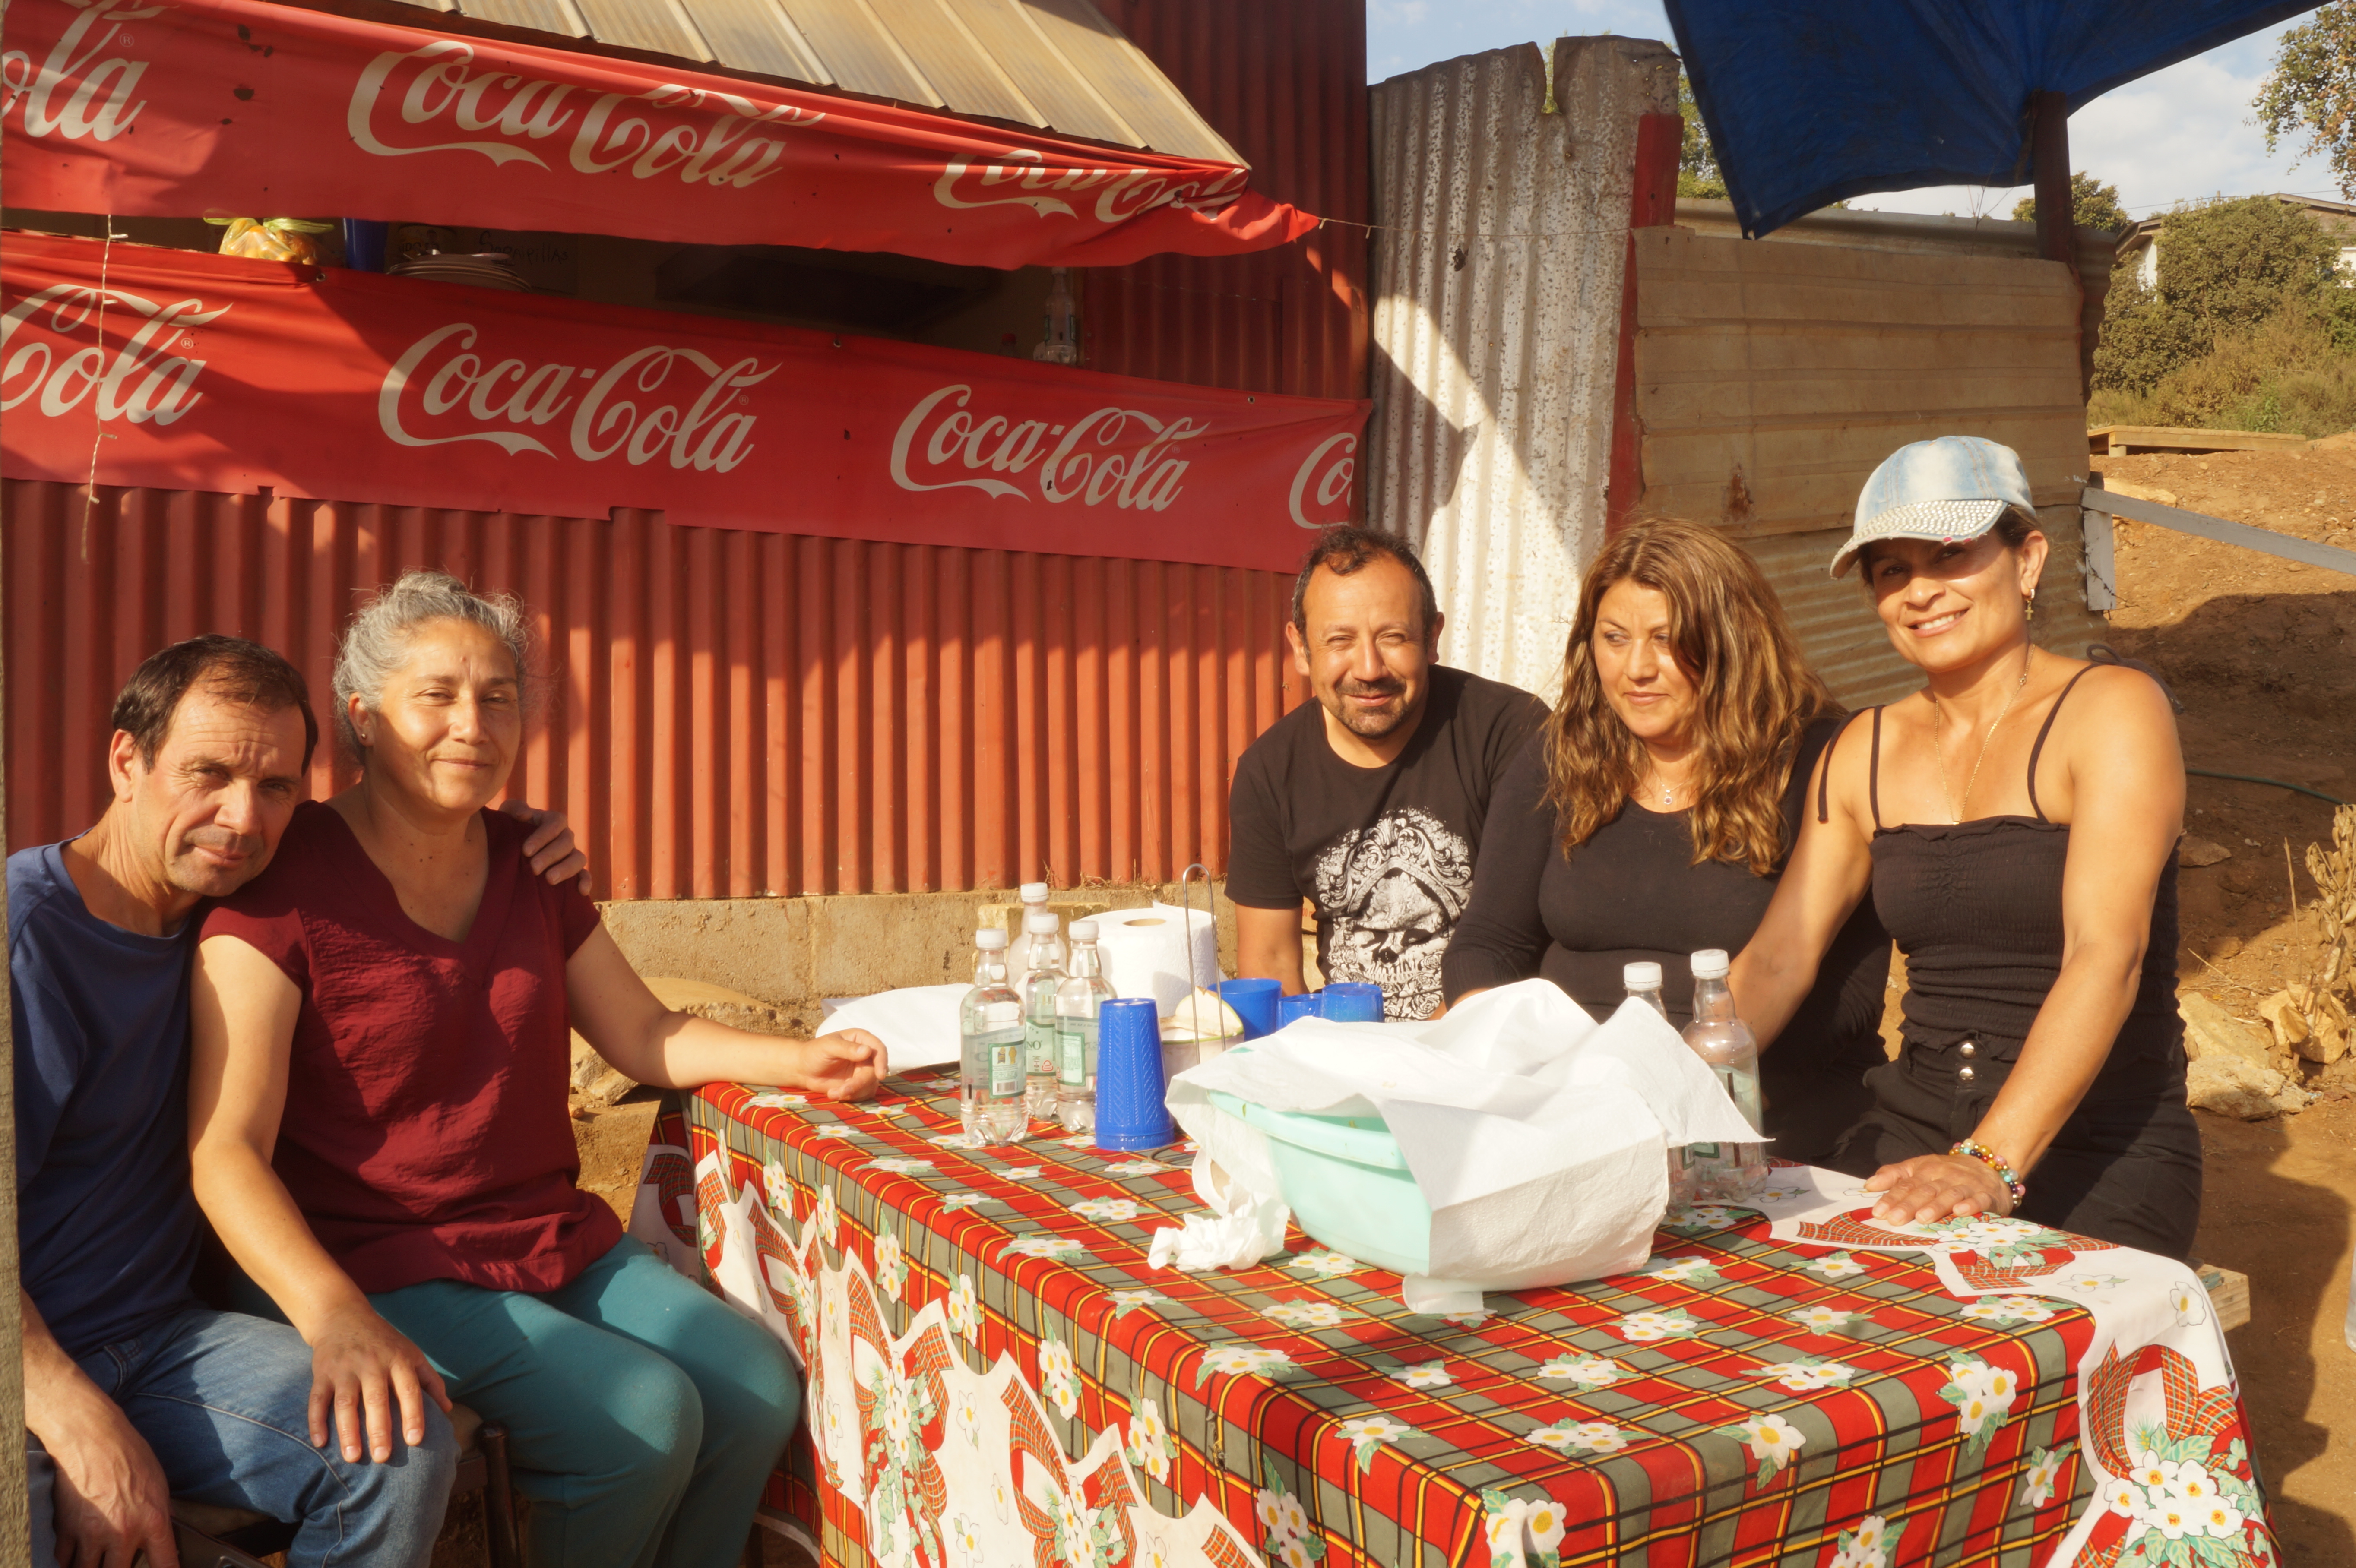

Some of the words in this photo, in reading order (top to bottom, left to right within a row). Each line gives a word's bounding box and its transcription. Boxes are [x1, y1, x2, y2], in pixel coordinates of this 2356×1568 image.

[378, 322, 783, 473] Coca-Cola
[890, 384, 1211, 512] Coca-Cola
[1289, 432, 1357, 529] Co
